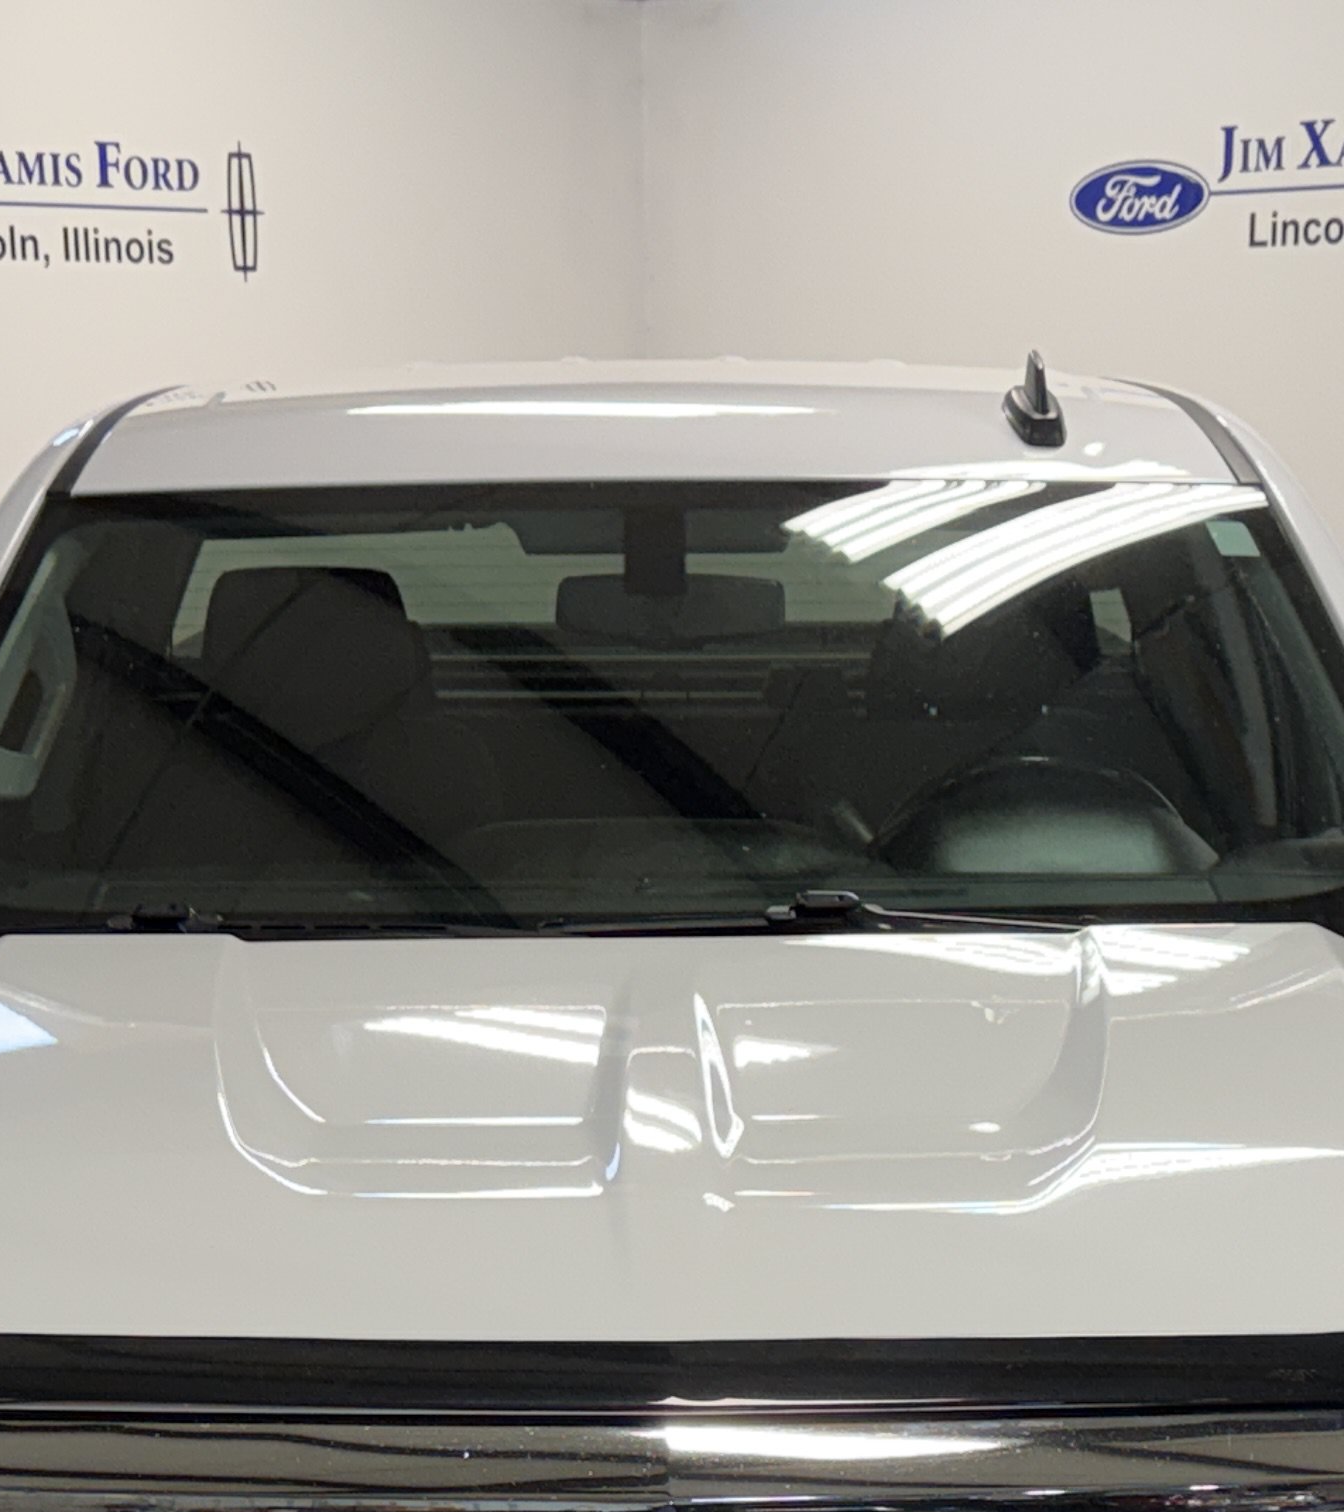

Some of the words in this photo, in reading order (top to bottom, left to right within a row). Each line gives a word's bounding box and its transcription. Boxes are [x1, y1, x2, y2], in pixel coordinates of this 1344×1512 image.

[93, 140, 201, 192] FORD
[1216, 125, 1286, 184] JIM
[1096, 173, 1182, 222] Ford
[61, 225, 175, 266] Illinois
